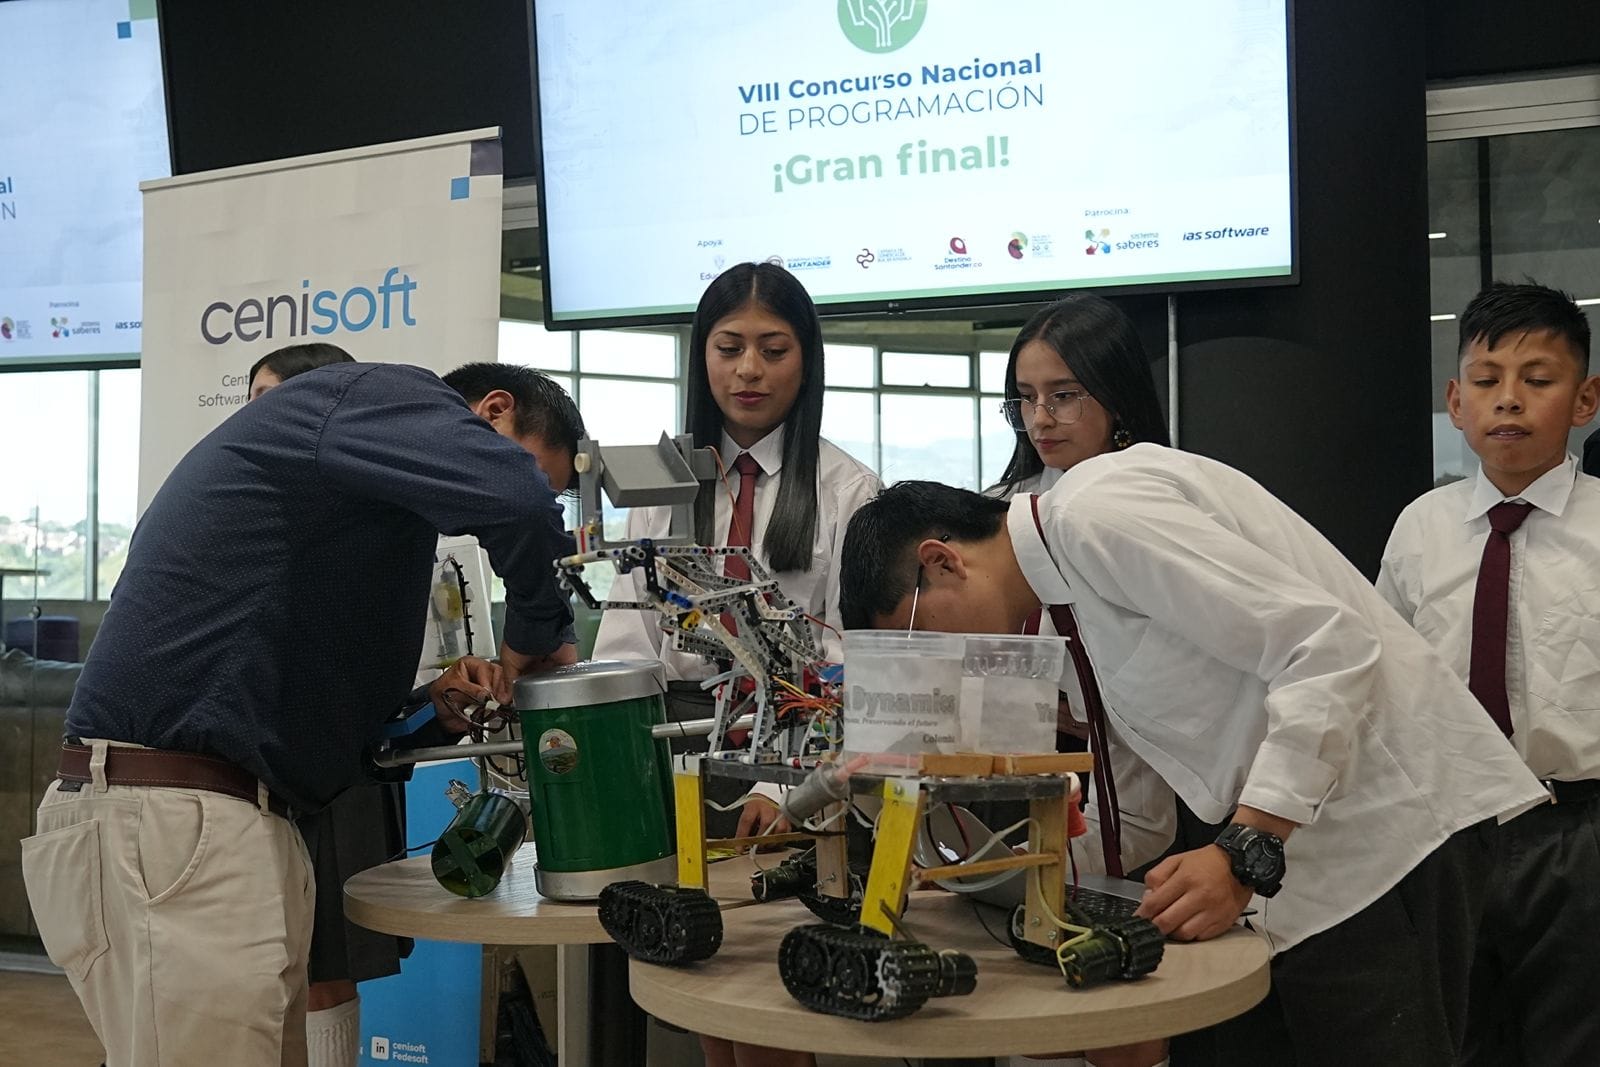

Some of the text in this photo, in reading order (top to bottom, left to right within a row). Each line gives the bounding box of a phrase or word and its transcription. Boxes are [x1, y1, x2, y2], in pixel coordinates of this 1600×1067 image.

[738, 52, 1041, 104] VIII Concurso Nacional
[740, 81, 1044, 135] DE PROGRAMACIÓN
[773, 135, 1010, 193] ¡Gran final!
[1130, 232, 1159, 240] sistema
[1182, 226, 1270, 241] ias software
[1116, 240, 1160, 250] saberes
[788, 260, 831, 268] SANTANDER
[201, 267, 417, 345] cenisoft
[222, 374, 249, 387] Cent
[852, 685, 956, 717] Dynamics
[907, 718, 915, 726] el
[916, 720, 938, 728] futuro
[922, 733, 955, 744] Colombi
[392, 1042, 426, 1053] cenisoft
[392, 1051, 429, 1064] Fedesoft
